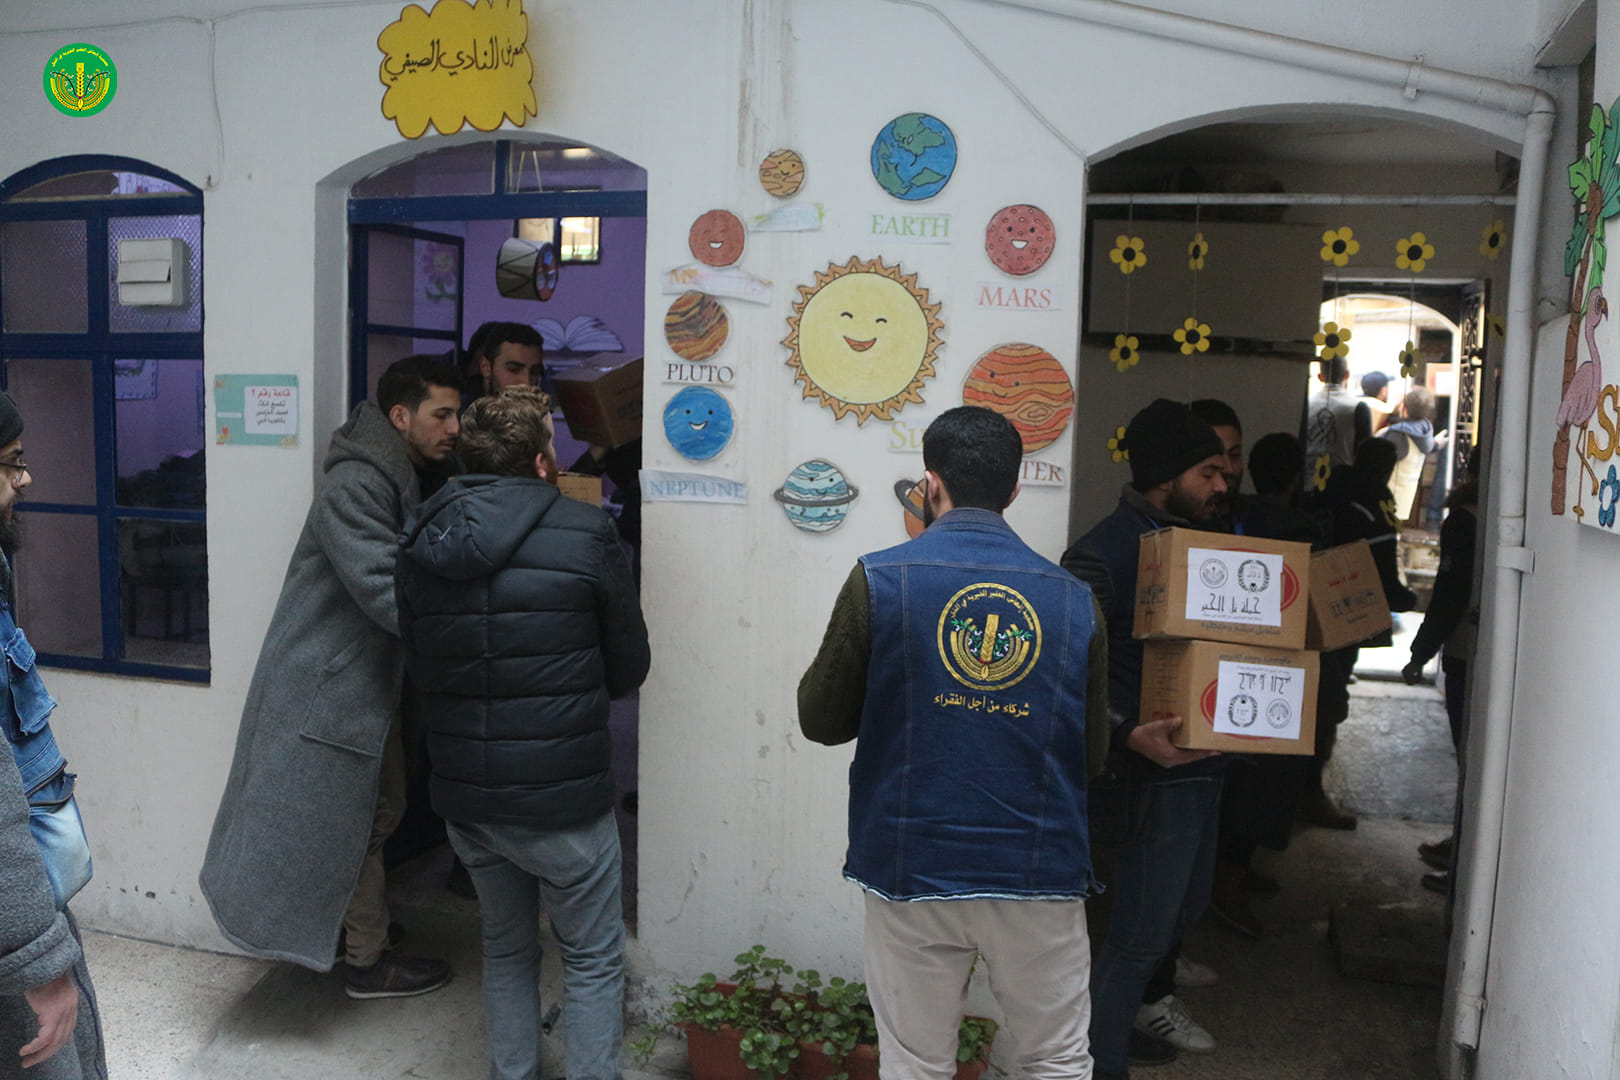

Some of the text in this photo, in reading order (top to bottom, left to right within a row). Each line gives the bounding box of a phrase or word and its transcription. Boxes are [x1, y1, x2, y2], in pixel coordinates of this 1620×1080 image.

[384, 38, 441, 82] الصيفي
[438, 35, 499, 76] النادي
[871, 214, 950, 238] EARTH
[978, 286, 1052, 309] MARS
[667, 362, 734, 384] PLUTO
[650, 479, 744, 499] NEPTUNE
[1201, 593, 1225, 612] الخير
[934, 692, 966, 707] الفقراء
[987, 699, 1001, 713] من
[1003, 702, 1030, 718] شركاء
